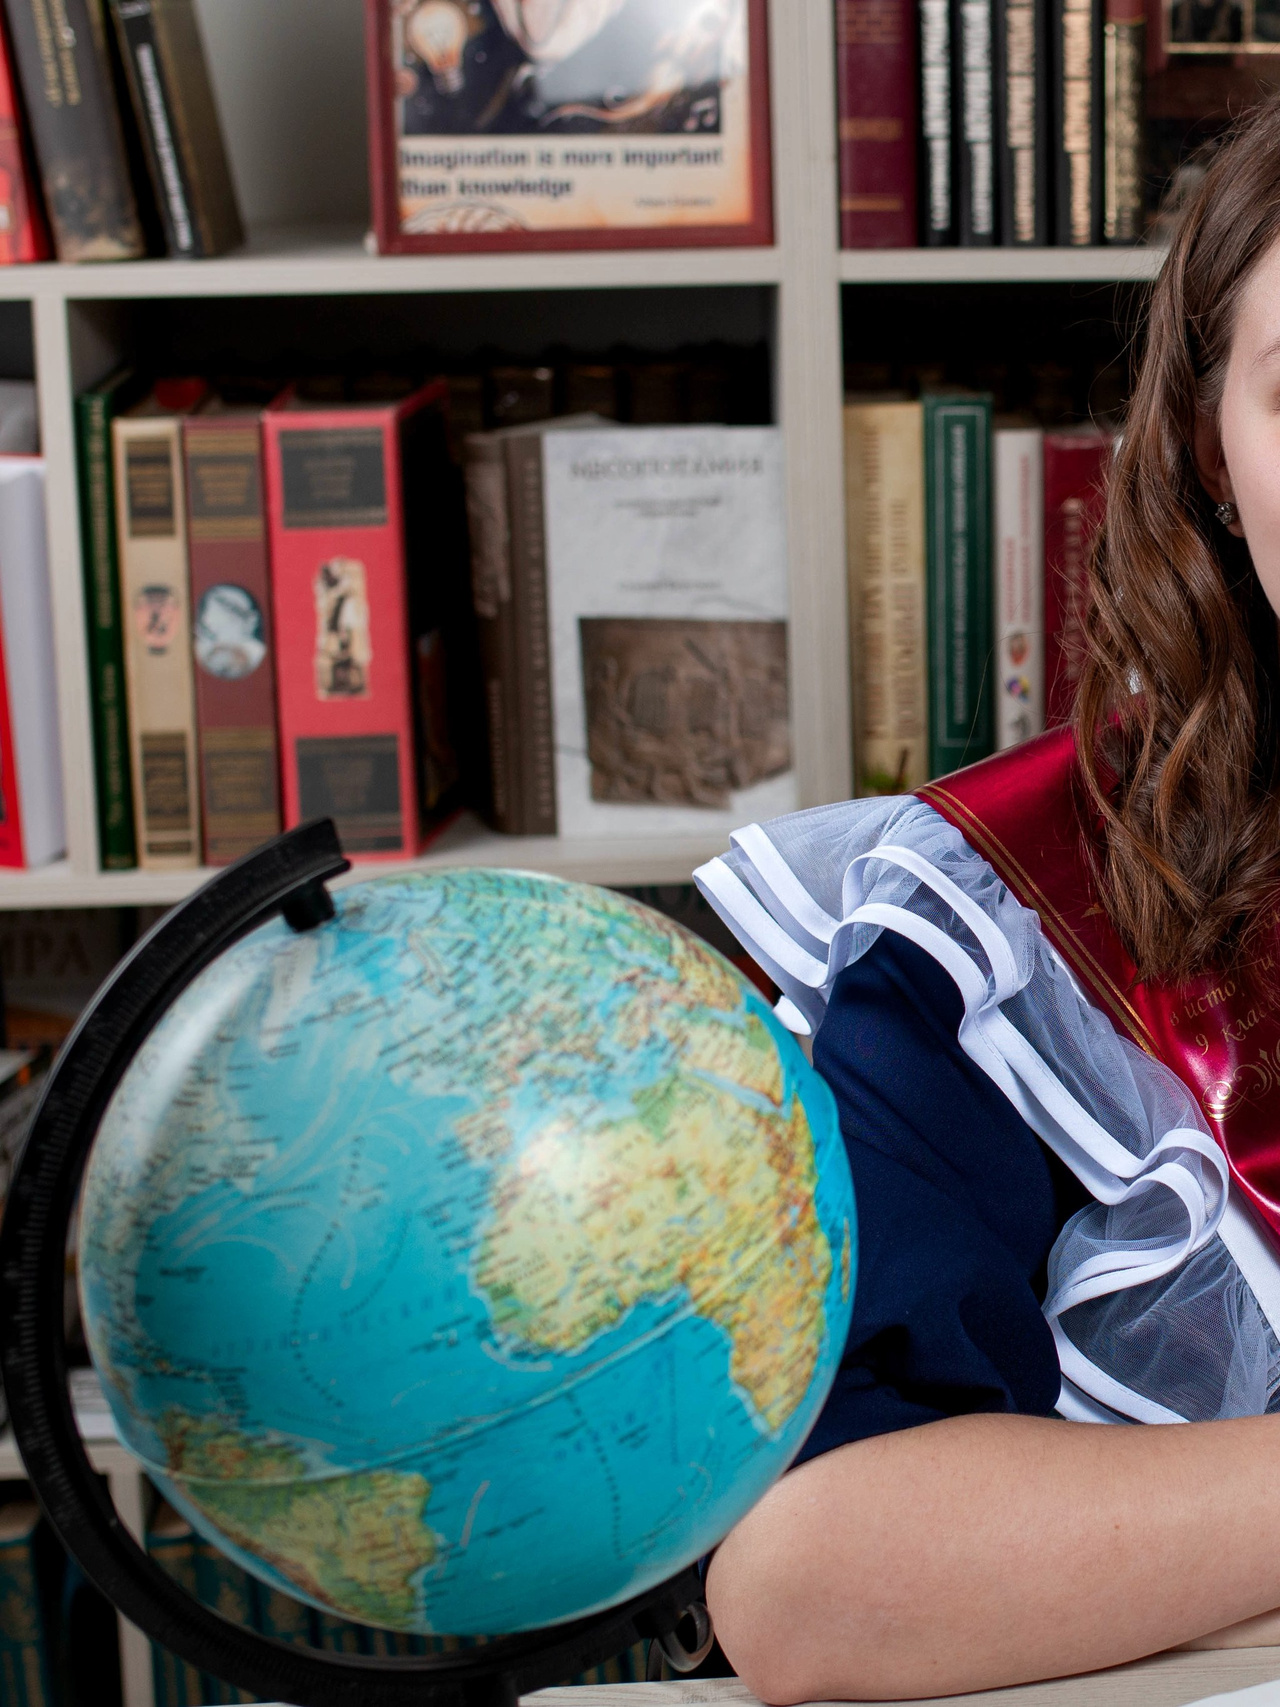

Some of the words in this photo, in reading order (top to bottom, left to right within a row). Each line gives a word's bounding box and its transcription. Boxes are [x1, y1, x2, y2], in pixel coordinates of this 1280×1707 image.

[400, 147, 527, 171] Imagination
[537, 147, 554, 167] is
[565, 149, 613, 167] more
[624, 147, 723, 171] important
[400, 177, 447, 197] than
[459, 177, 572, 201] knowledge
[1195, 1033, 1209, 1056] 9
